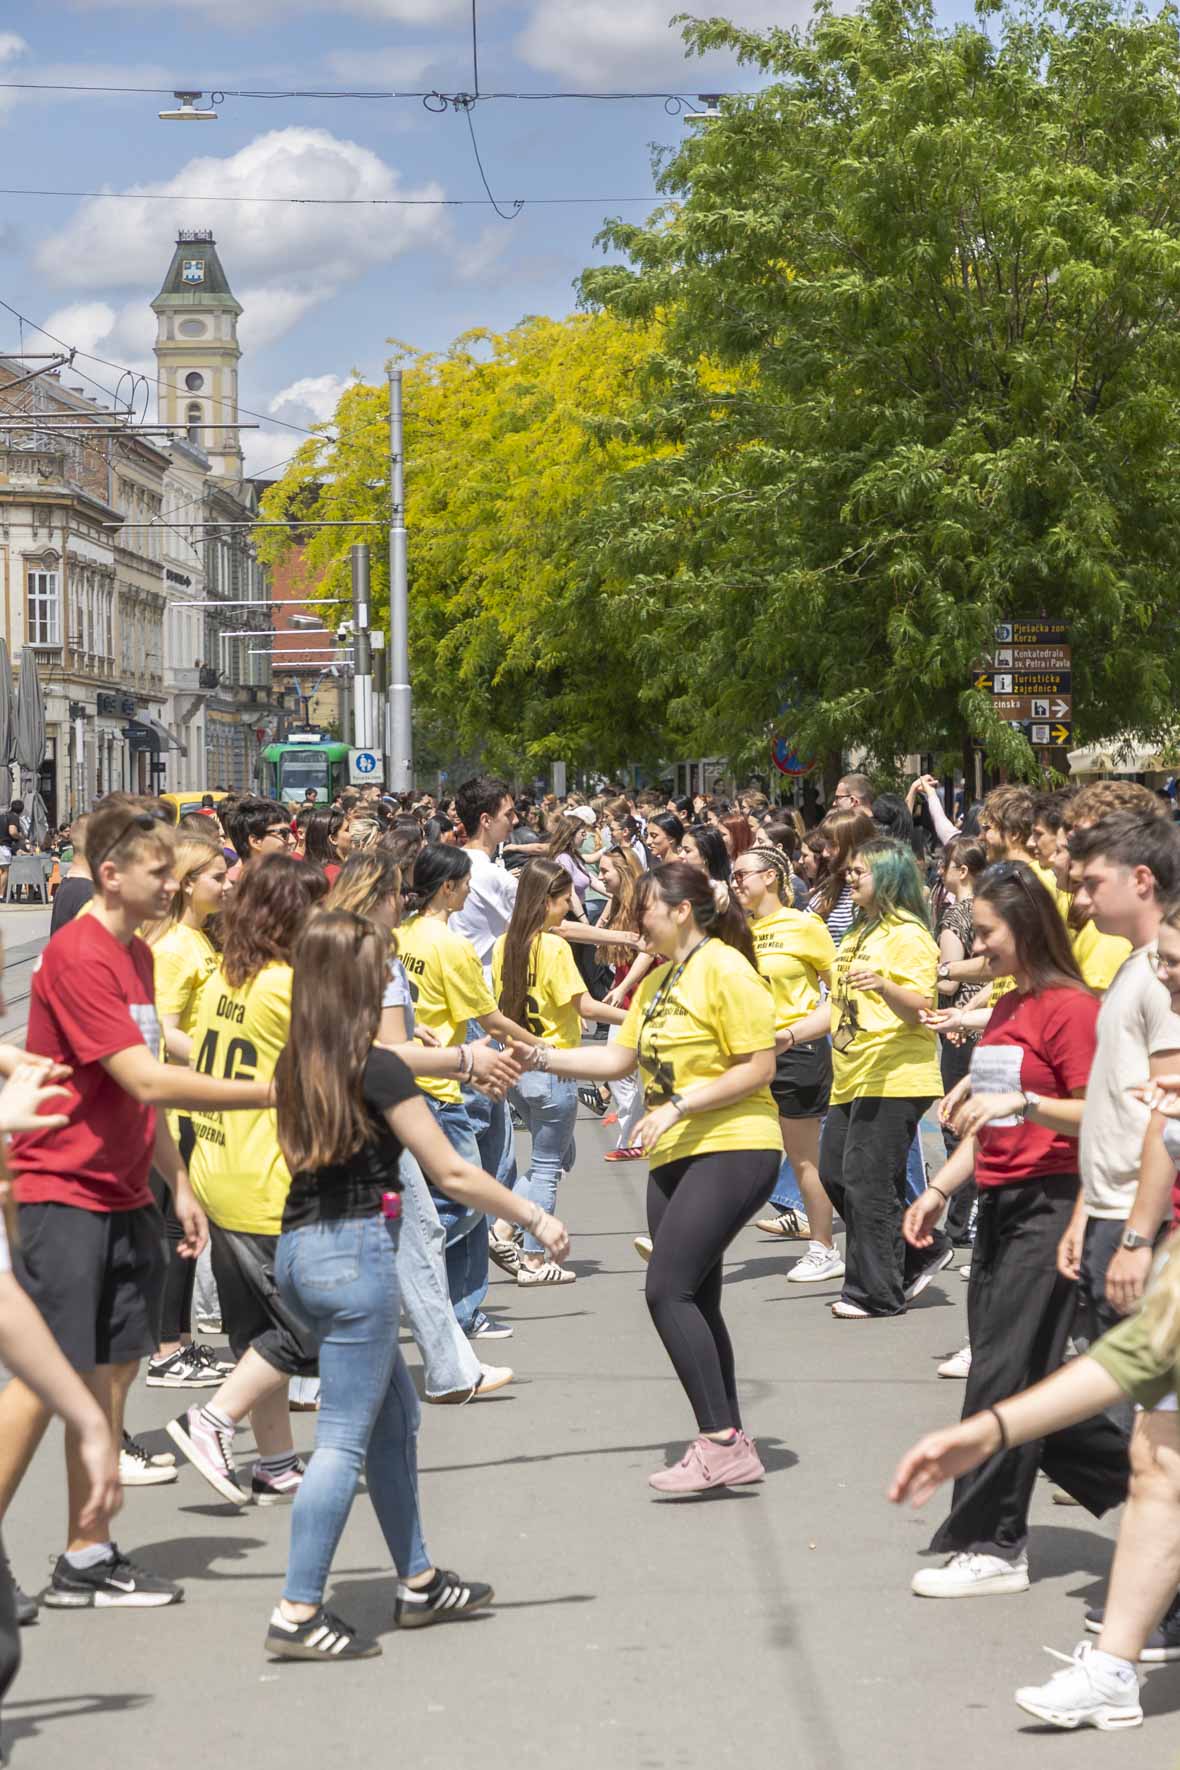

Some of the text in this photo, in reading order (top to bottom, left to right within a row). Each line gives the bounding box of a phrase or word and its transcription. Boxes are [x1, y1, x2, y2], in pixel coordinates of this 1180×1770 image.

[1051, 624, 1069, 632] zon
[1014, 634, 1037, 643] Korzo
[1014, 649, 1064, 658] Konkatedrala
[1026, 659, 1045, 668] Petra
[1051, 659, 1071, 668] Pavla
[1014, 674, 1061, 683] Turistička
[1014, 684, 1057, 694] zajednica
[993, 699, 1021, 708] cinska
[216, 994, 246, 1025] Dora
